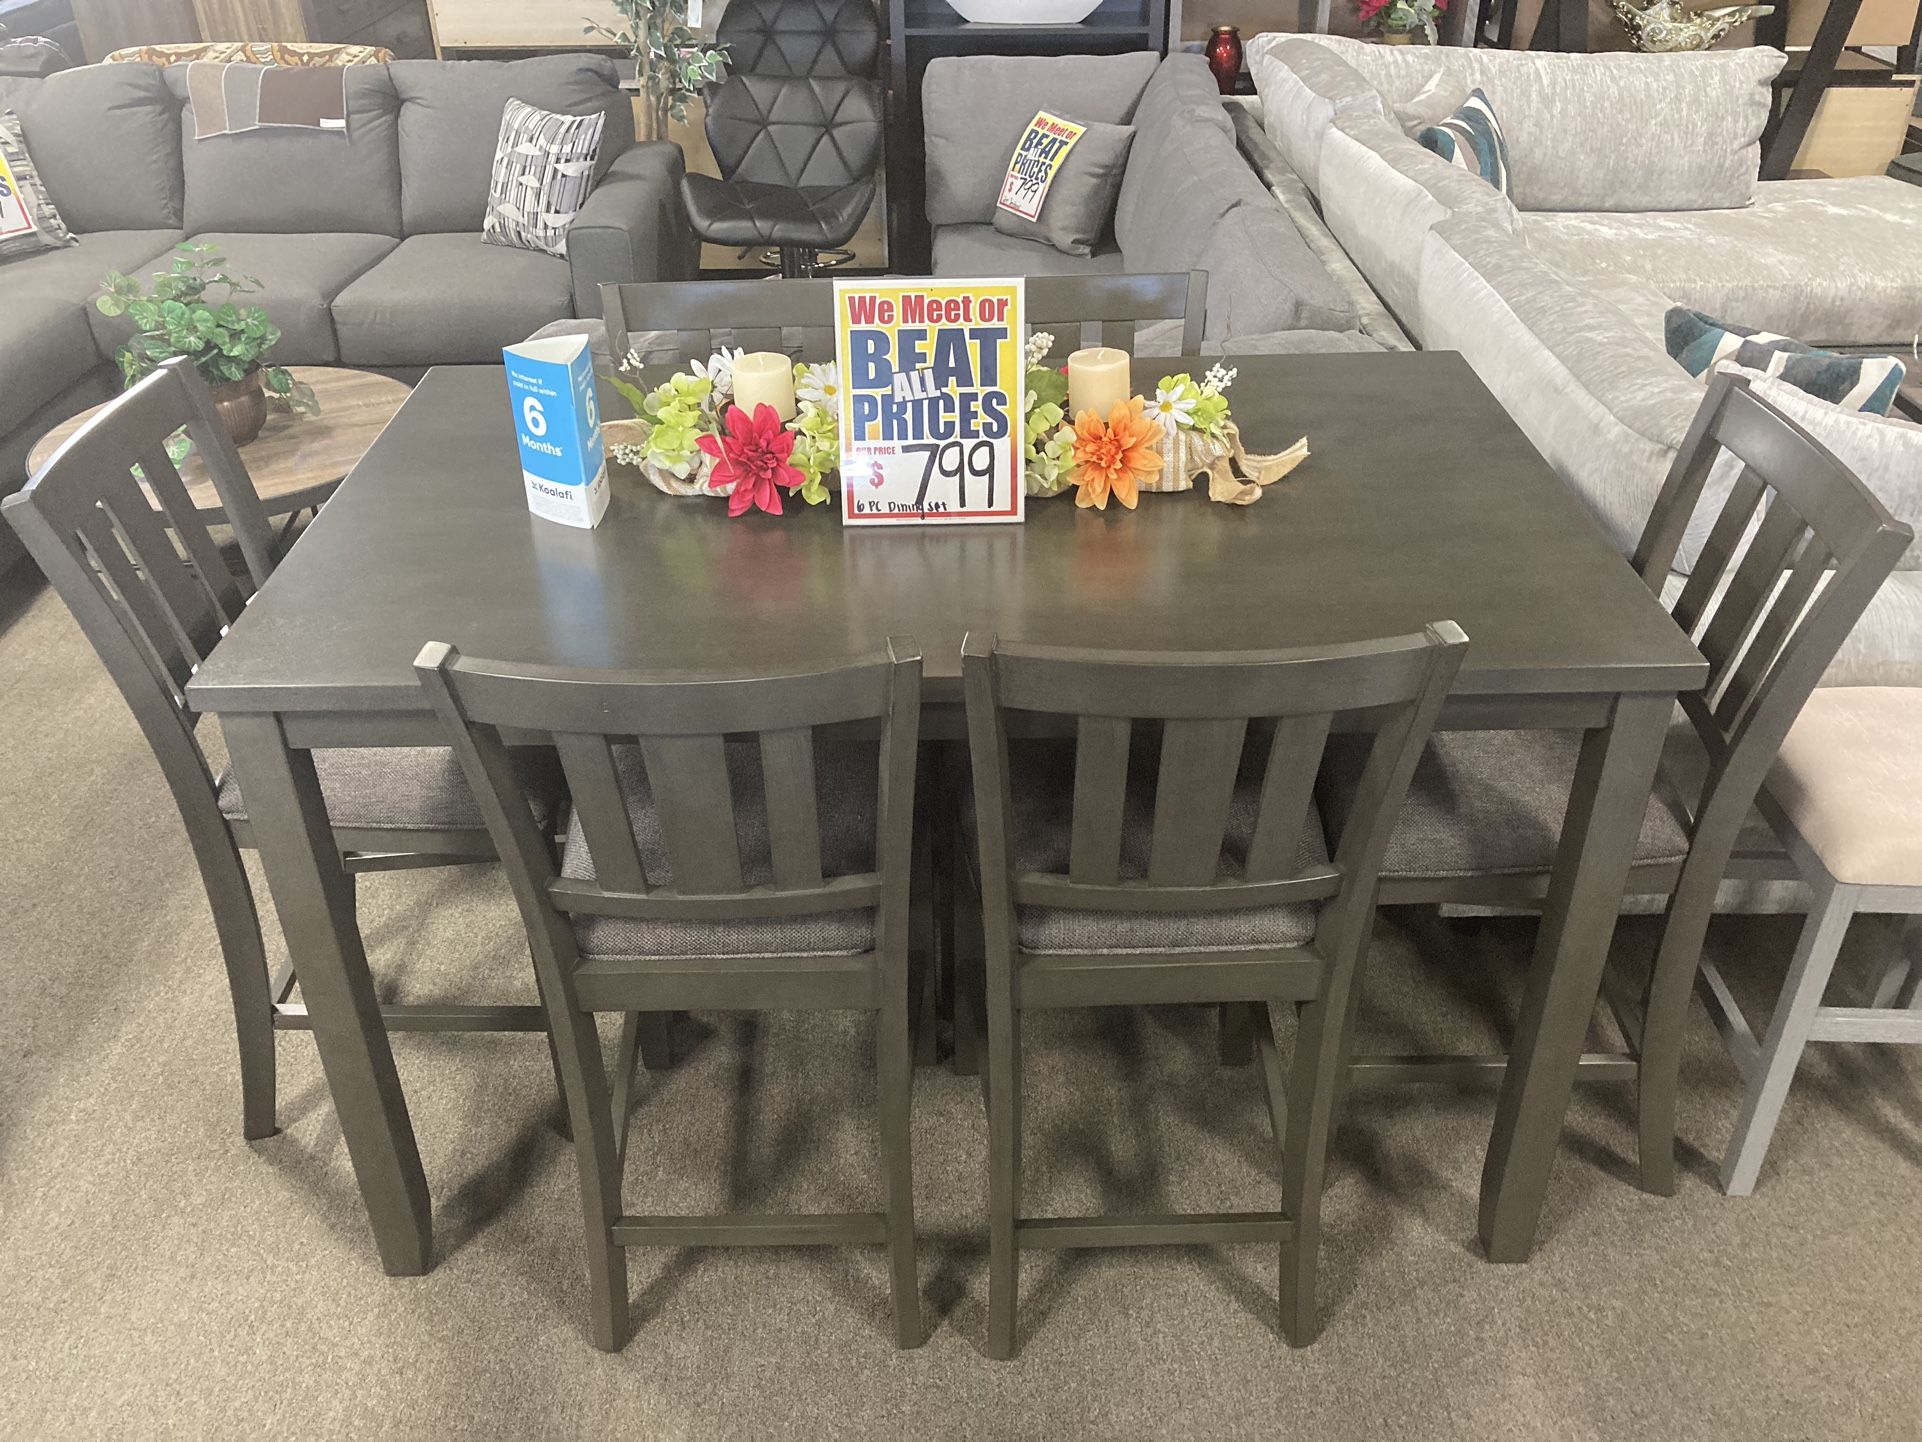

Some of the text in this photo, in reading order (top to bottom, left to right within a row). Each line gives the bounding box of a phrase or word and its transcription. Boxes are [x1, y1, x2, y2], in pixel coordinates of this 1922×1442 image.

[1021, 128, 1069, 162] BEAT
[1034, 117, 1077, 141] We Meet or
[1012, 152, 1052, 183] PRICES
[1008, 181, 1014, 192] $
[1015, 177, 1039, 203] 799
[848, 294, 1008, 325] We Meet or
[850, 327, 1008, 390] BEAT
[893, 368, 941, 402] ALL
[523, 396, 547, 436] 6
[586, 387, 595, 428] 6
[853, 391, 1009, 441] PRICES
[874, 446, 896, 455] PRICE
[869, 441, 995, 508] $ 799
[538, 483, 573, 500] Koalafi
[857, 500, 864, 512] 6
[869, 501, 882, 512] PC
[888, 501, 925, 520] Dining
